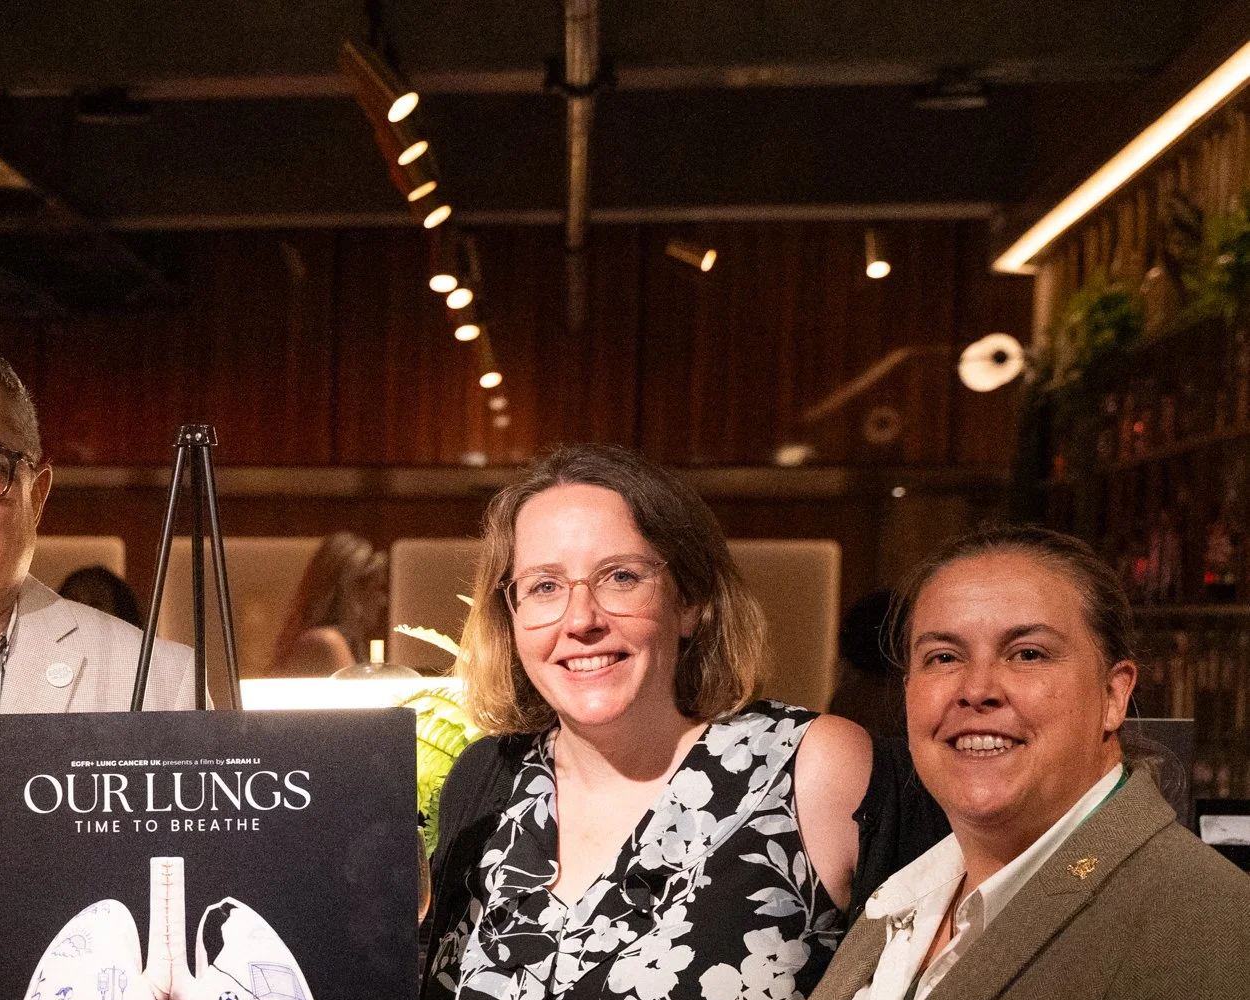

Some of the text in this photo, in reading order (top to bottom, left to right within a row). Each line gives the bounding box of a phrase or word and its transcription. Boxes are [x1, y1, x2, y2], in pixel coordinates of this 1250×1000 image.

[24, 770, 311, 814] OUR LUNGS
[75, 818, 260, 833] TIME TO BREATHE
